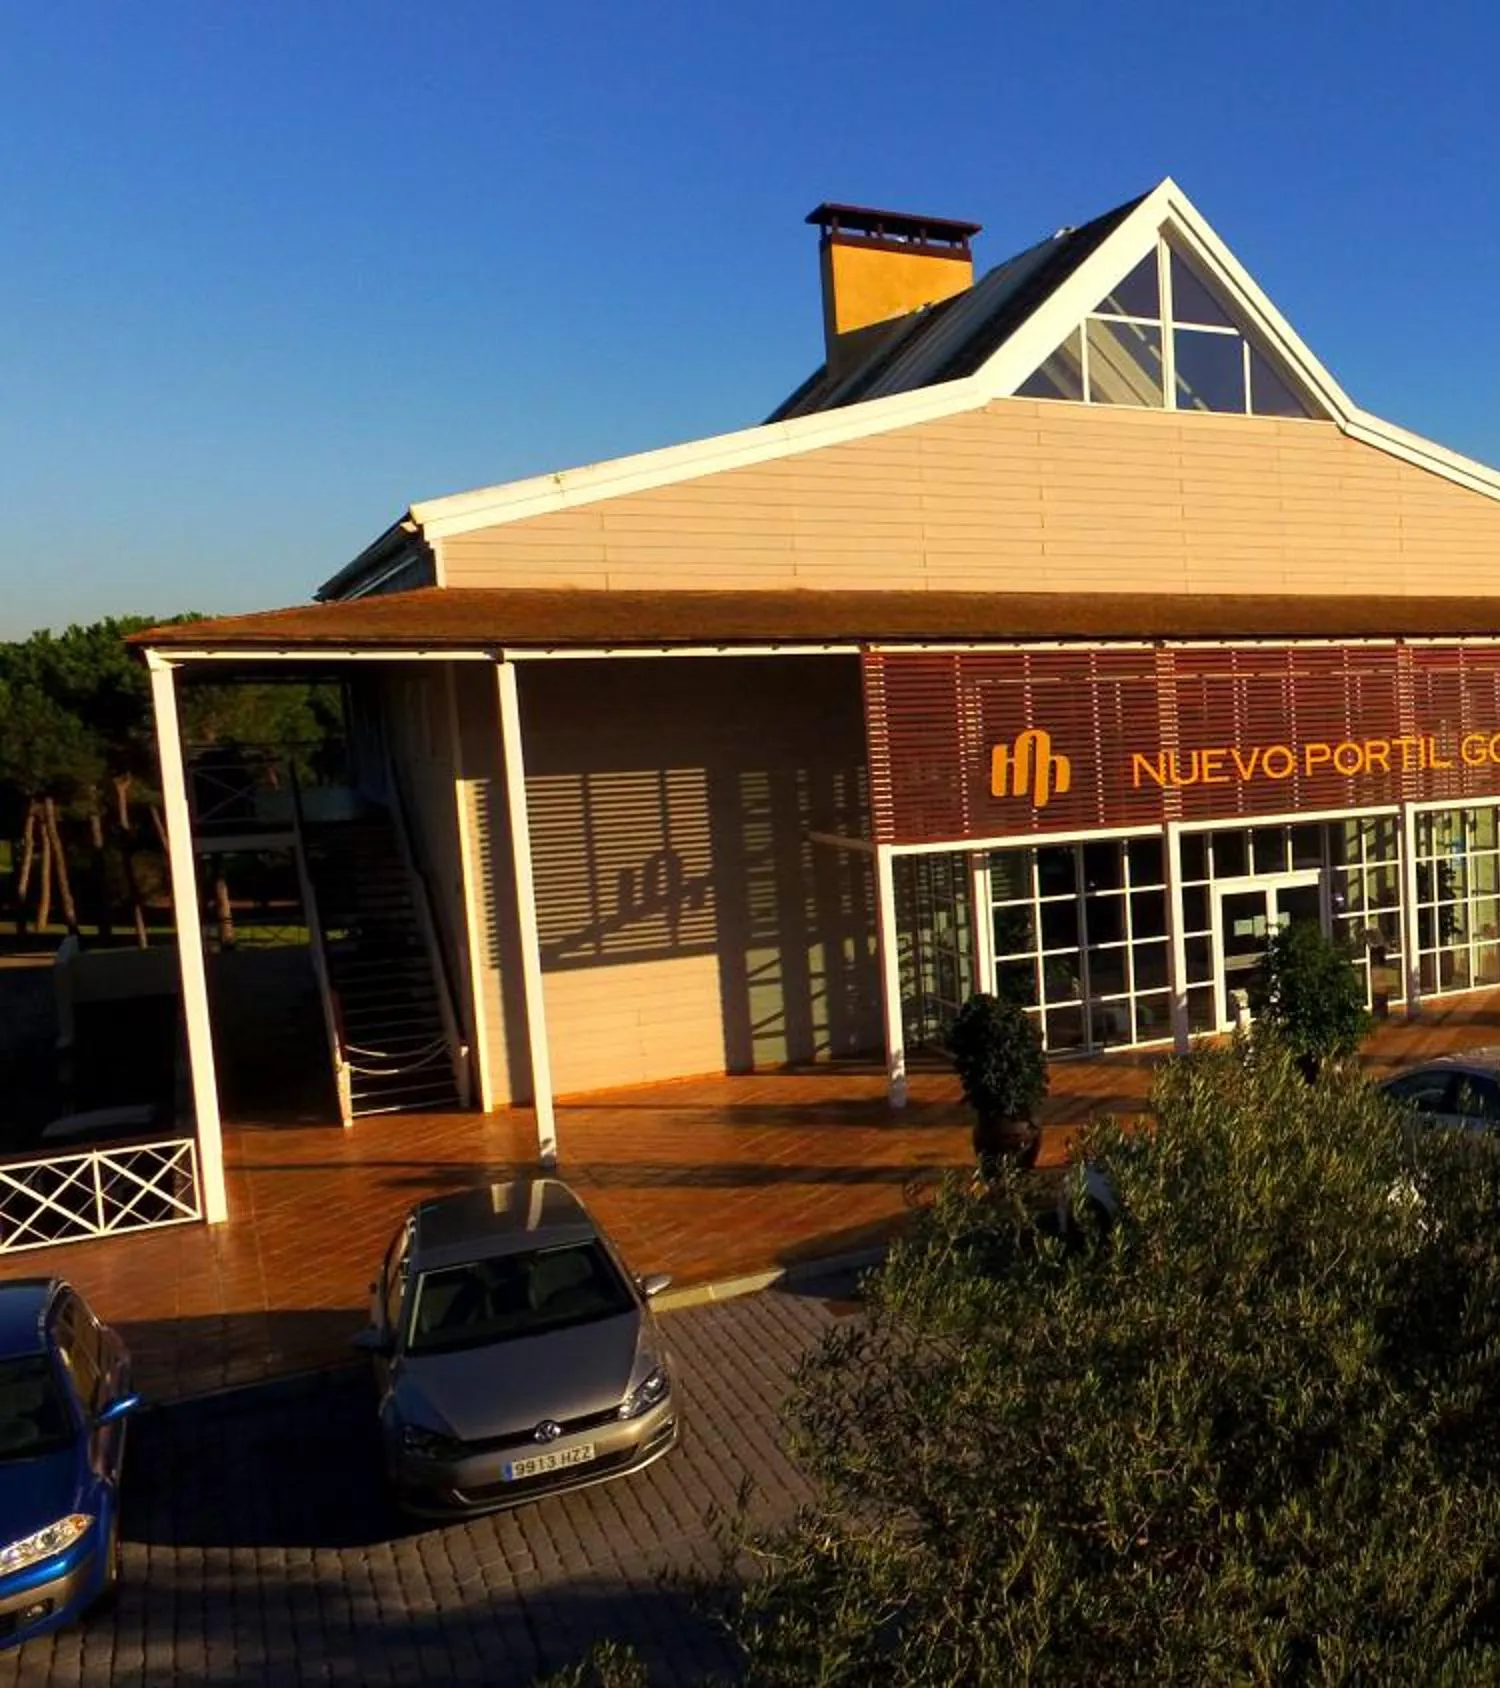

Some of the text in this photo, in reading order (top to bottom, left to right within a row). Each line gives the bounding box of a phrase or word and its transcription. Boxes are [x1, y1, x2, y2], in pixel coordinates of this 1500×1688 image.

[1132, 745, 1294, 788] NUEVO
[1304, 734, 1452, 776] PORTIL
[515, 1456, 557, 1476] 9913
